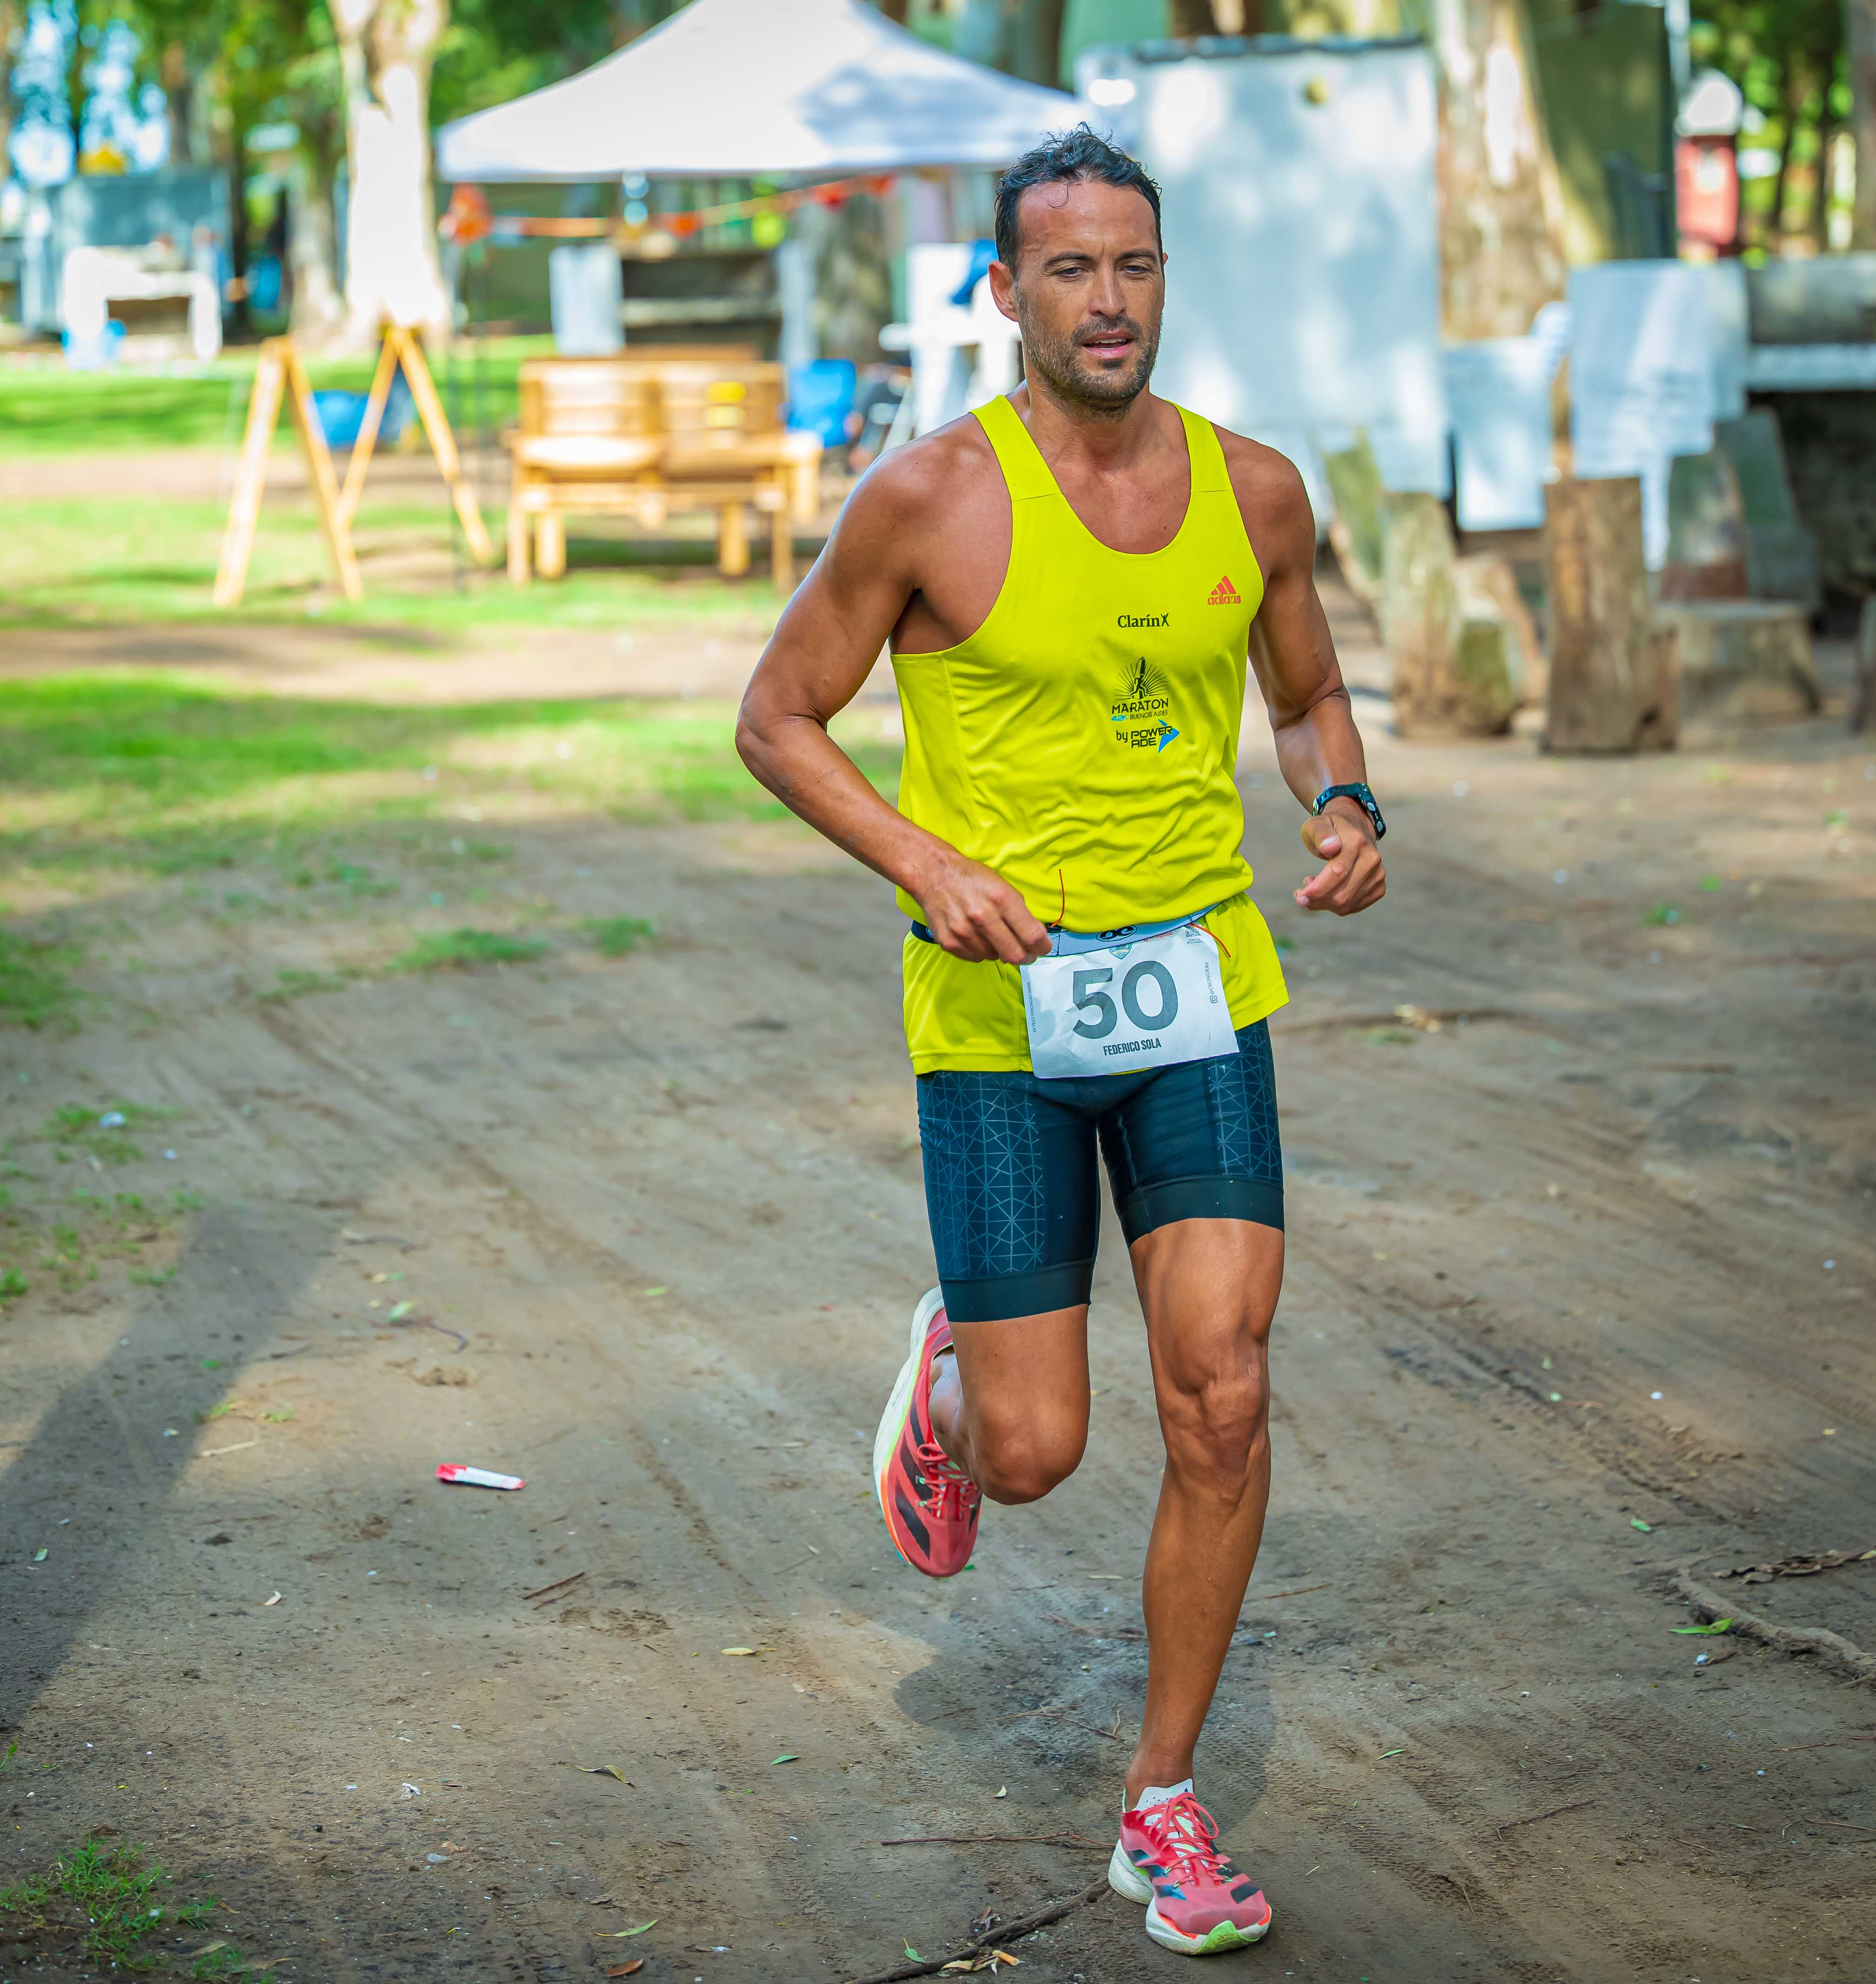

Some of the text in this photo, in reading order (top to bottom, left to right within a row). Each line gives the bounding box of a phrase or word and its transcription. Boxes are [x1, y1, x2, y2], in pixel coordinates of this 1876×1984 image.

[1118, 614, 1161, 628] Clarín
[1112, 698, 1169, 714] MARATON
[1130, 711, 1152, 720] BUENOS
[1116, 726, 1172, 743] by POWER
[1131, 737, 1157, 748] ADE
[1204, 962, 1214, 995] @CRONORAV
[1072, 960, 1178, 1039] 50
[1103, 1038, 1162, 1056] FEDERICO SOLA
